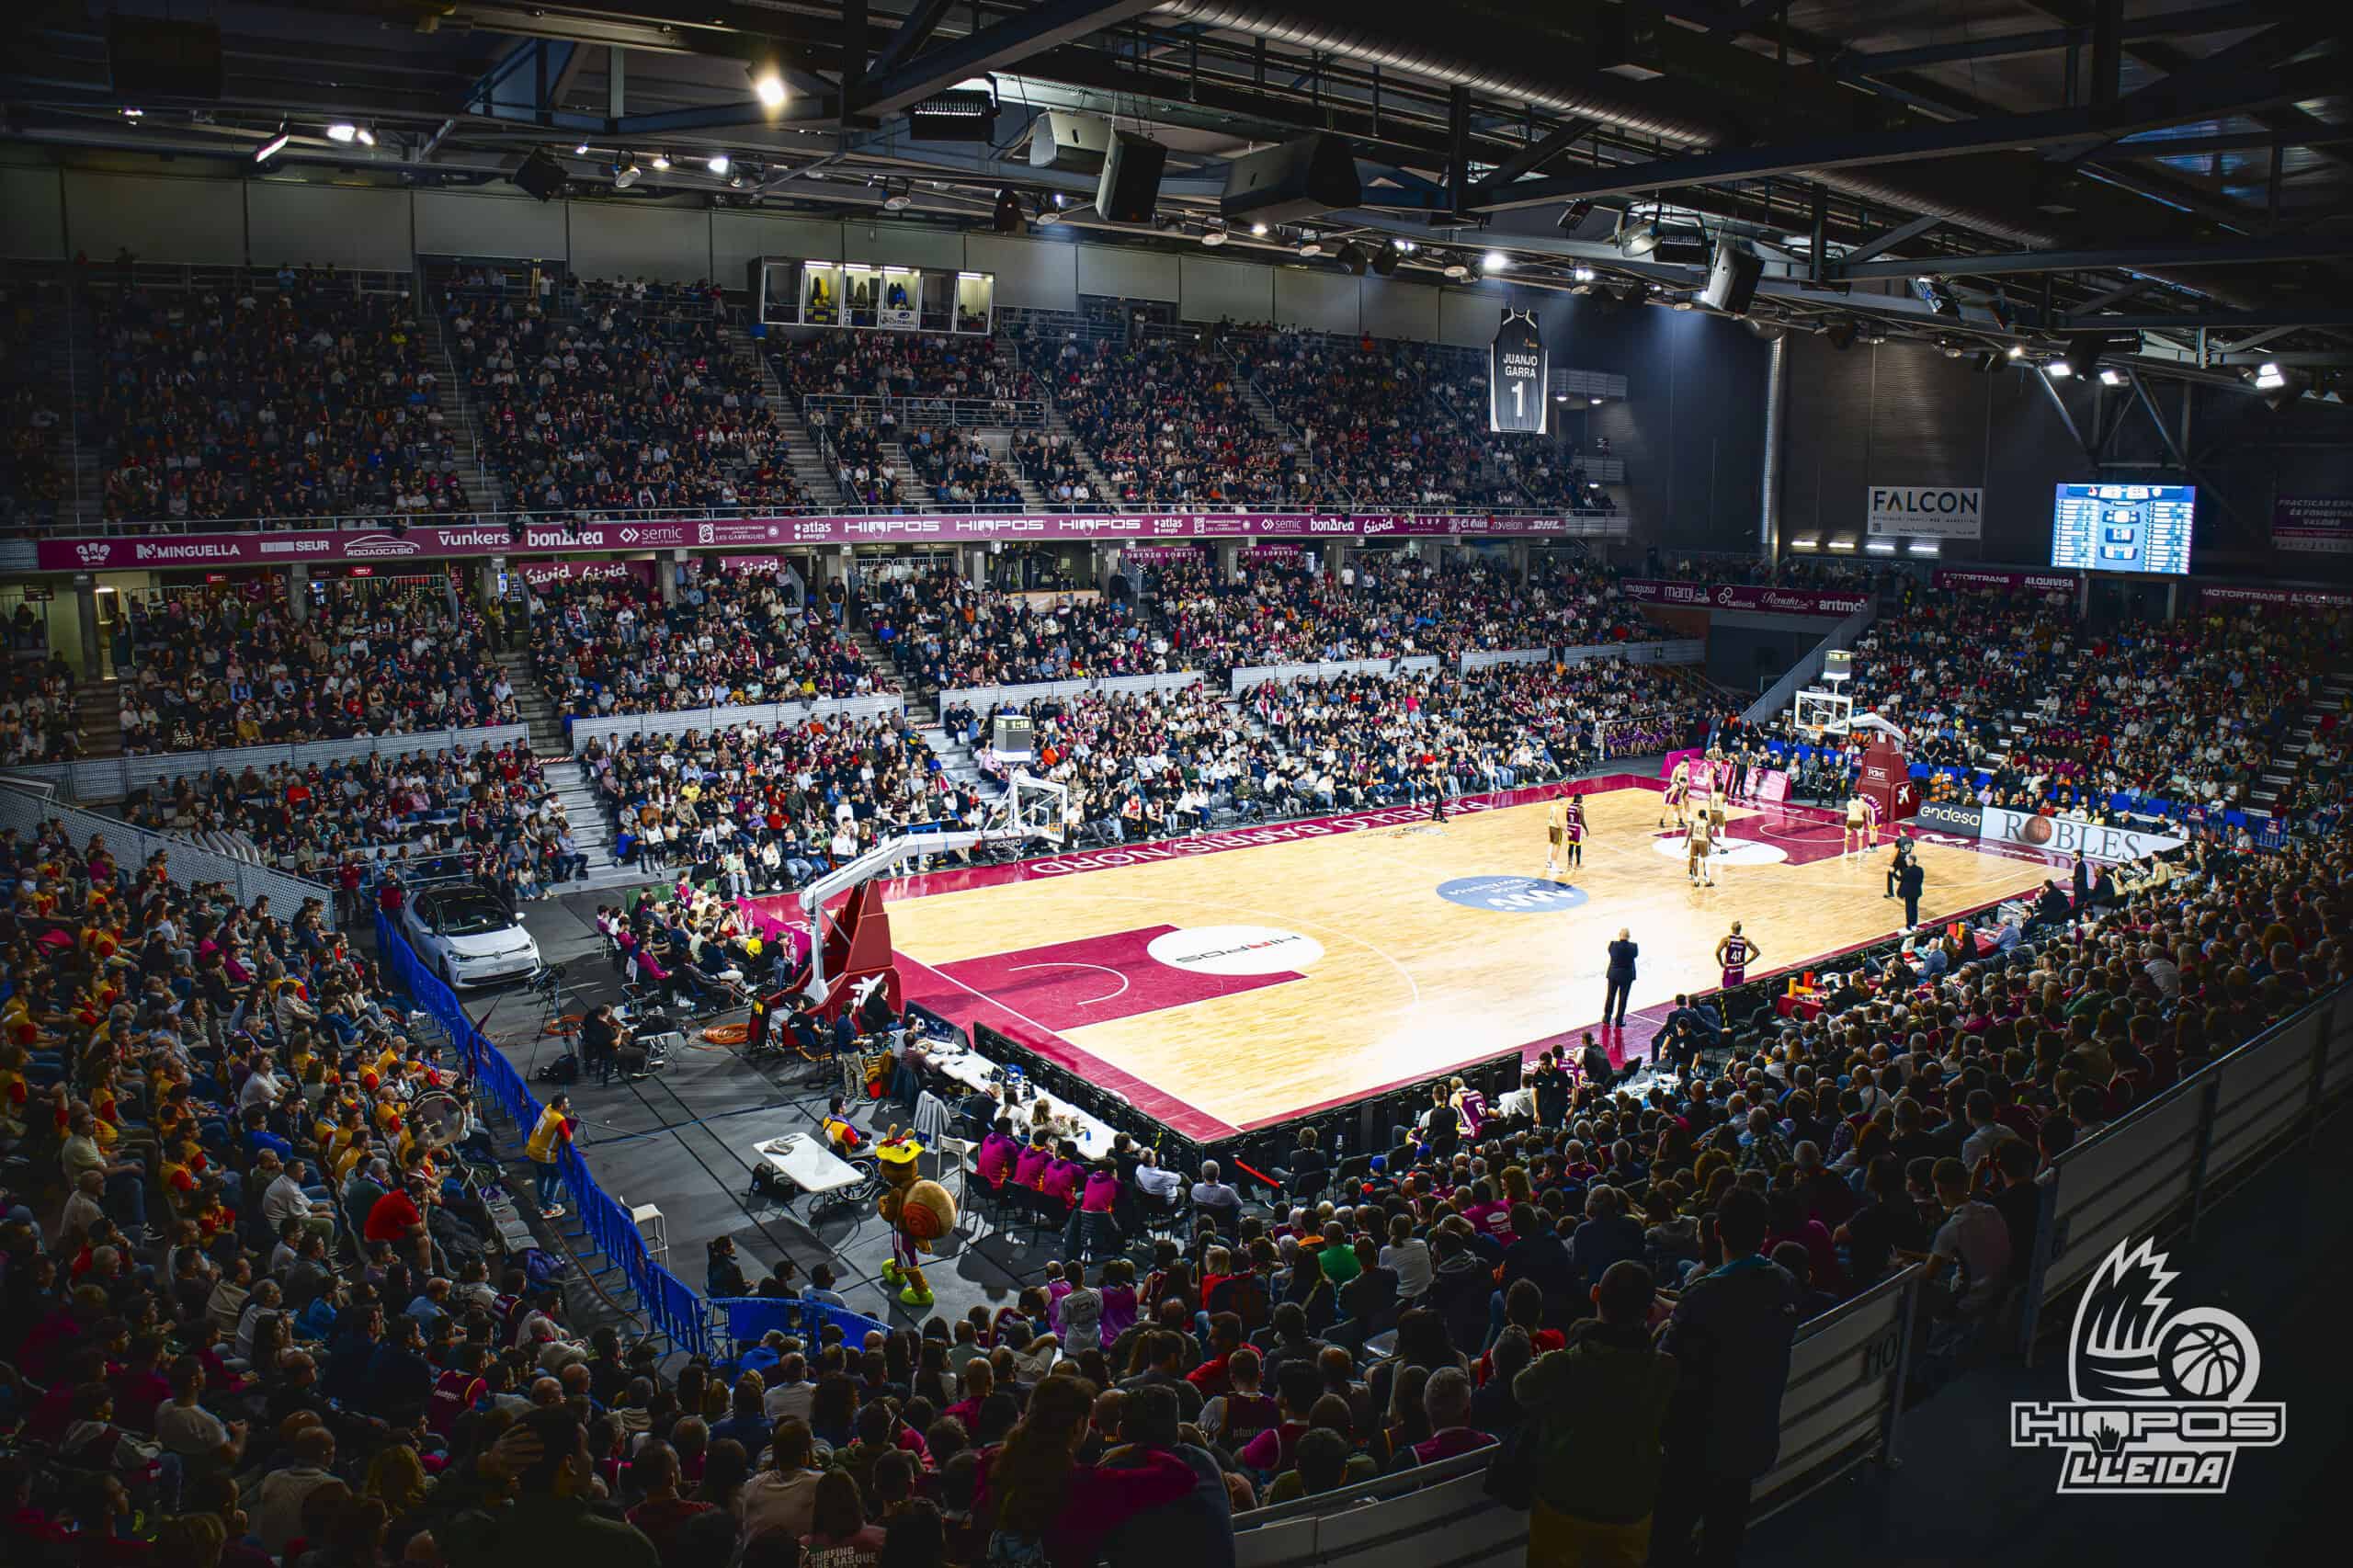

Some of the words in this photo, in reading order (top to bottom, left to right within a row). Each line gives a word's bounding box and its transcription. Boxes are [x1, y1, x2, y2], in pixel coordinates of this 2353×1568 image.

[1503, 353, 1538, 367] JUANJO
[1505, 366, 1536, 379] GARRA
[1511, 381, 1524, 417] 1
[1873, 490, 1978, 515] FALCON
[802, 521, 832, 533] atlas
[1160, 517, 1183, 528] atlas
[1275, 518, 1302, 529] semic
[642, 525, 684, 540] semic
[157, 544, 241, 559] MINGUELLA
[295, 540, 330, 552] SEUR
[1920, 806, 1981, 826] endesa
[2003, 812, 2141, 861] ROBLES
[1030, 847, 1173, 874] NORD
[1475, 1101, 1486, 1118] 6
